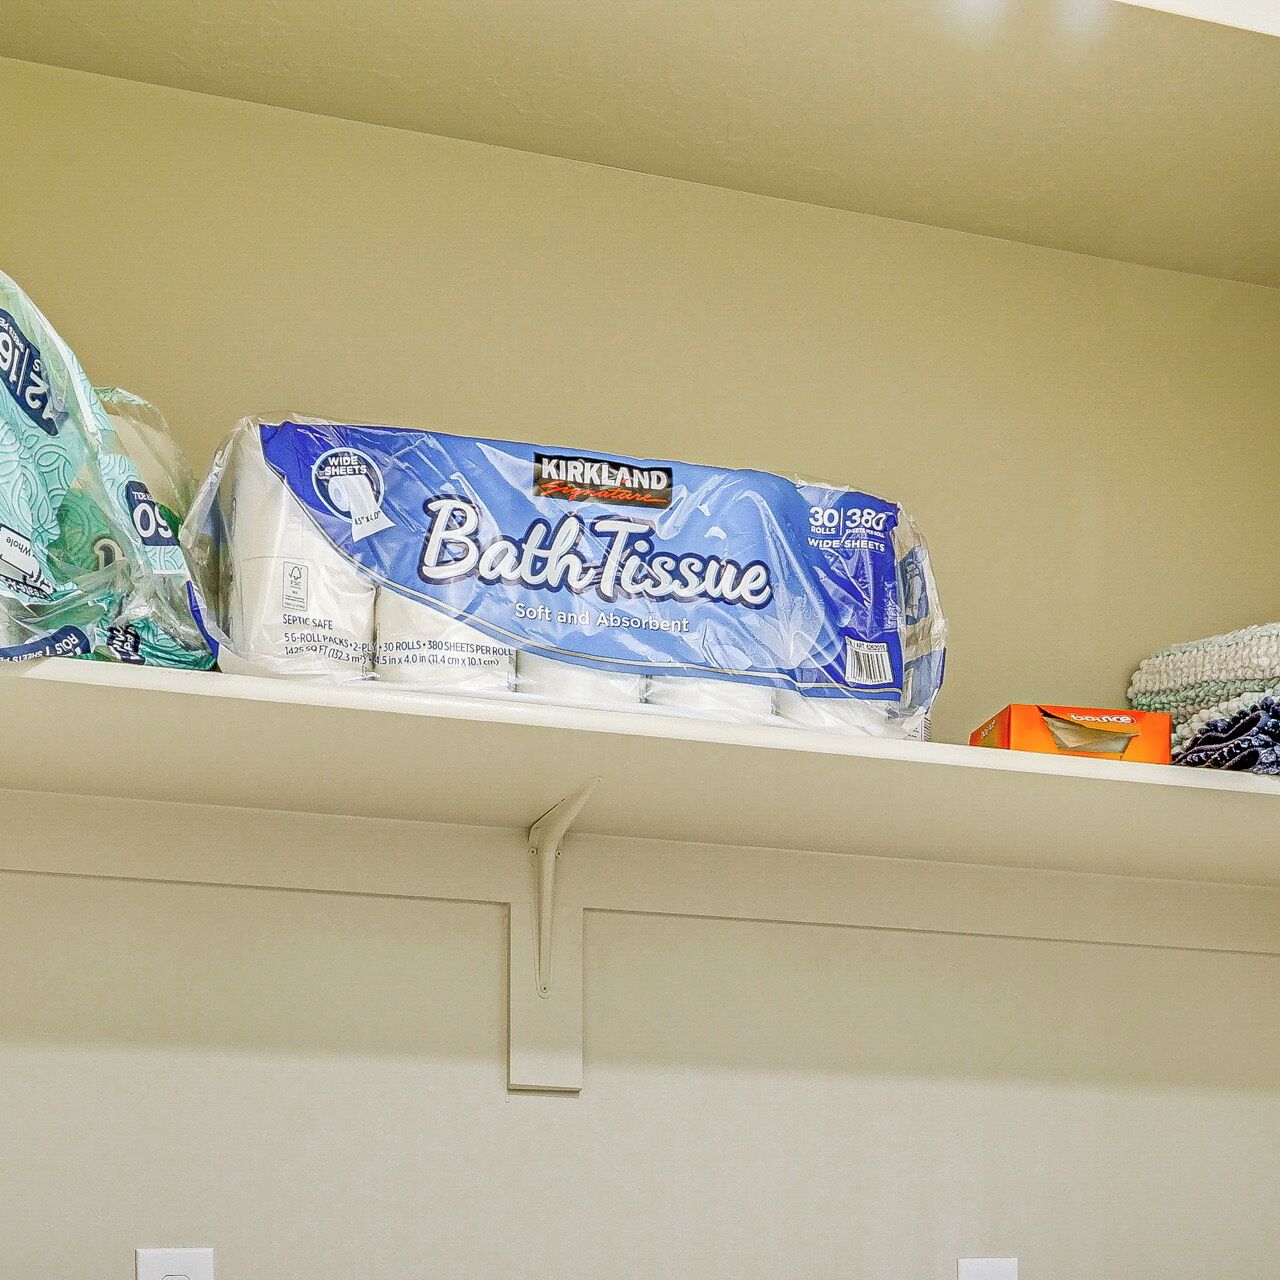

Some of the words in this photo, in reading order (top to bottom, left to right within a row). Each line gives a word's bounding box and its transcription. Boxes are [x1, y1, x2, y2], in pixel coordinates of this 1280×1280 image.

[324, 465, 368, 476] SHEETS
[327, 456, 359, 466] WIDE
[541, 458, 669, 491] KIRKLAND
[540, 480, 669, 504] Signature
[808, 507, 839, 528] 30
[845, 508, 886, 531] 380
[810, 526, 836, 535] ROLLS
[5, 536, 31, 557] Whole
[421, 499, 596, 596] Bath
[592, 518, 773, 603] Tissue
[807, 537, 841, 549] WIDE
[843, 539, 886, 553] SHEETS
[282, 614, 310, 628] SEPTIC
[312, 618, 333, 631] SAFE
[515, 603, 552, 622] Soft
[557, 610, 590, 627] and
[595, 613, 690, 634] Absorbent
[290, 633, 321, 643] 6-ROLL
[322, 635, 349, 649] PACKS
[383, 642, 394, 652] 30
[395, 641, 421, 651] ROLLS
[427, 640, 444, 650] 380
[444, 642, 475, 653] SHEETS
[475, 644, 491, 655] PER
[492, 646, 514, 657] ROLL
[388, 655, 397, 665] in
[404, 654, 418, 664] 4.0
